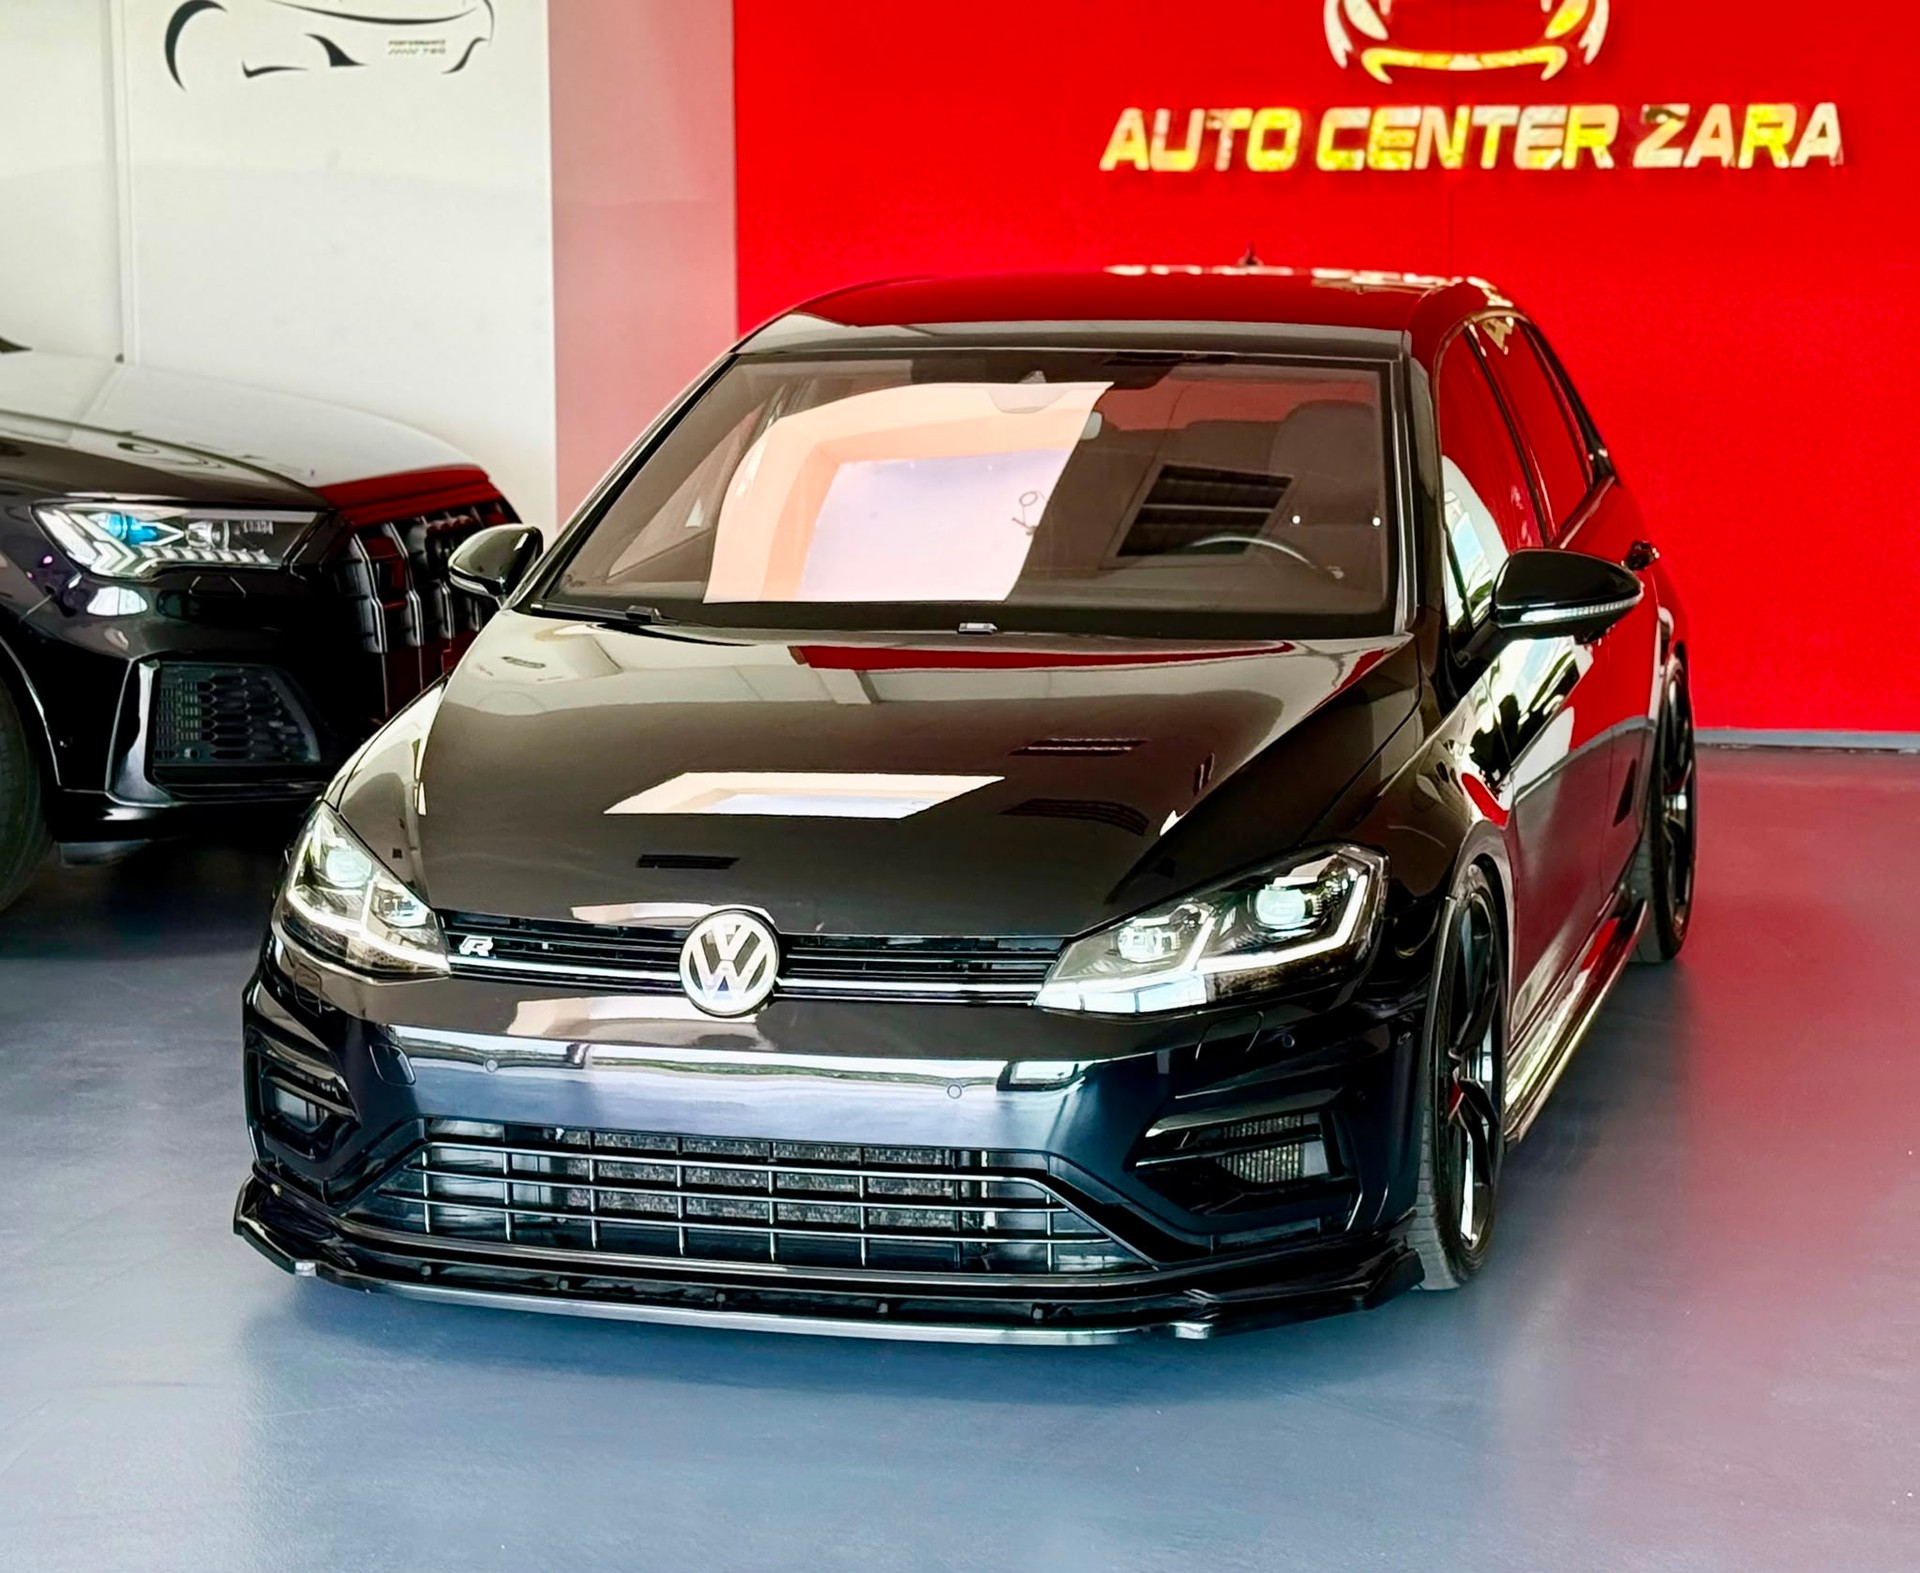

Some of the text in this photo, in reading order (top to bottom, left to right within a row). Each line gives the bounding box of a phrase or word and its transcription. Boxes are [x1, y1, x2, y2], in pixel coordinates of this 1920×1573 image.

[1099, 102, 1843, 172] AUTO CENTER ZARA
[459, 934, 494, 957] R
[682, 910, 778, 1014] VW
